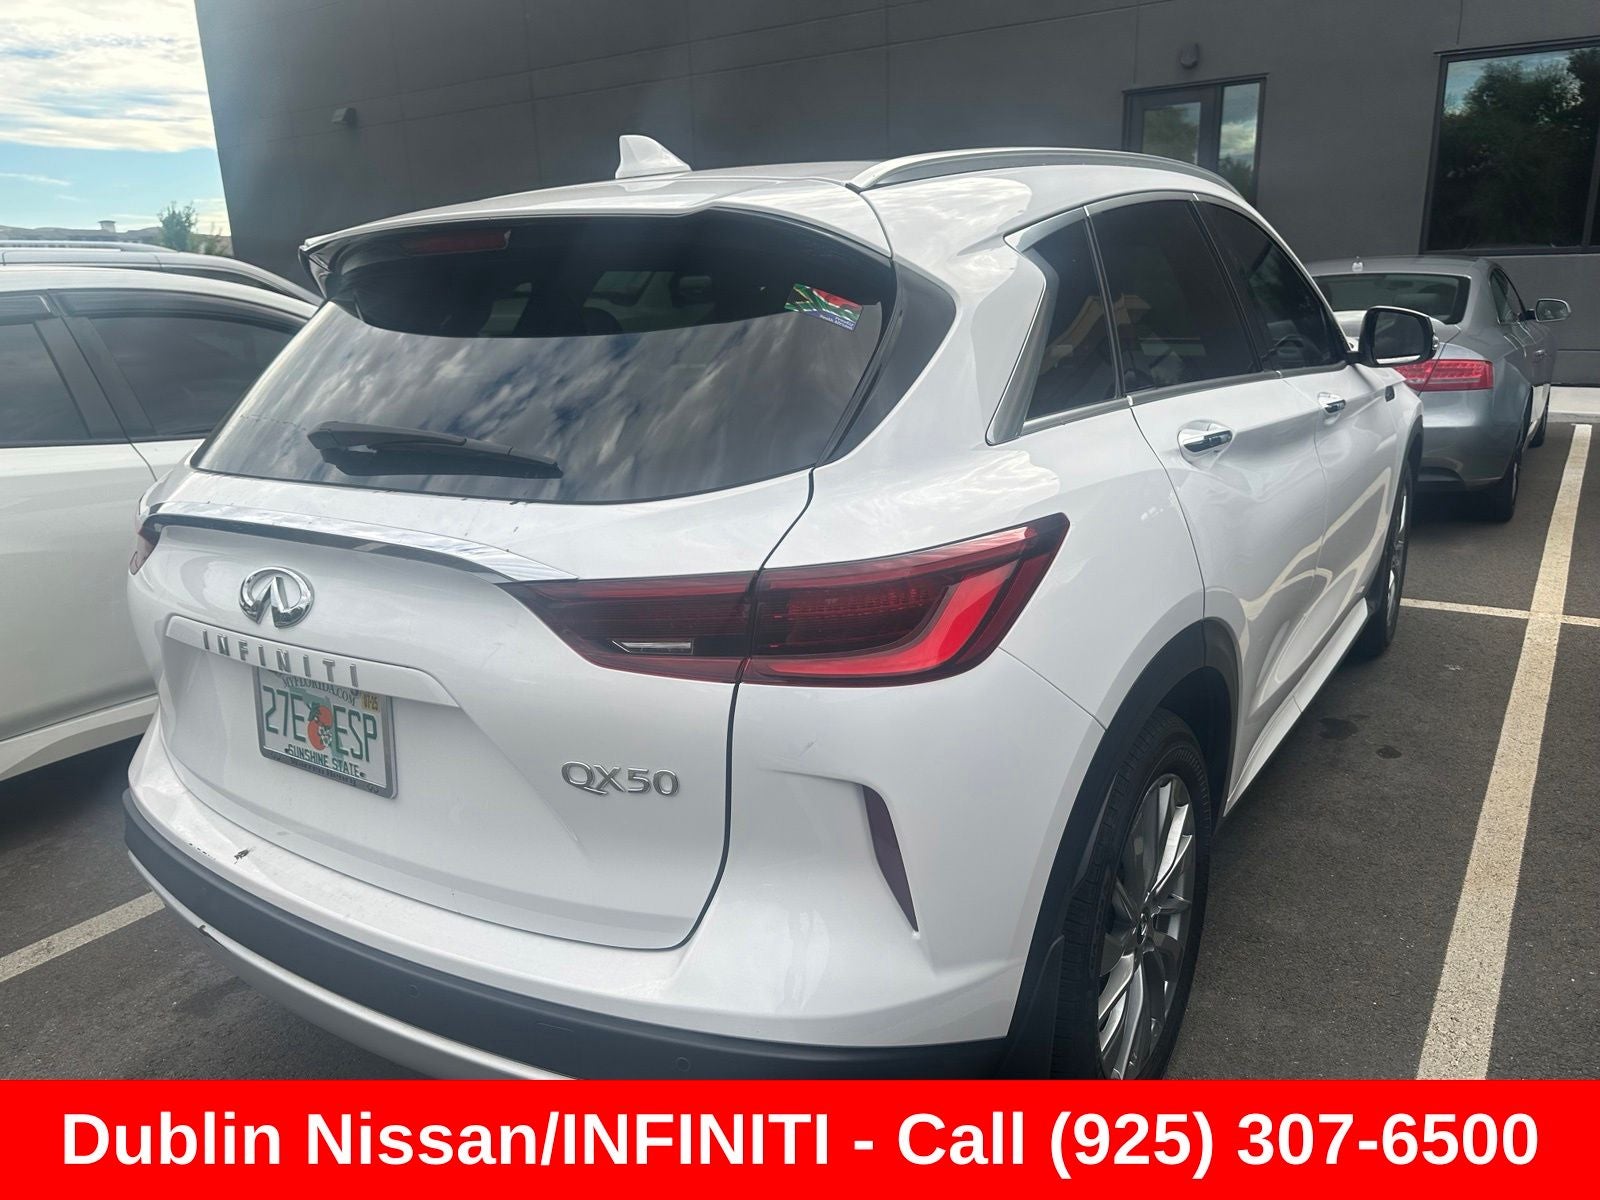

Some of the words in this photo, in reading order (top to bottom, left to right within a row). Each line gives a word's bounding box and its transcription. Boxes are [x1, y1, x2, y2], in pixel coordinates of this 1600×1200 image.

[202, 629, 359, 688] INFINITI
[263, 685, 307, 743] 27E
[333, 704, 377, 763] ESP
[287, 743, 329, 768] SUNSHINE
[332, 757, 361, 778] STATE
[561, 761, 680, 796] QX50
